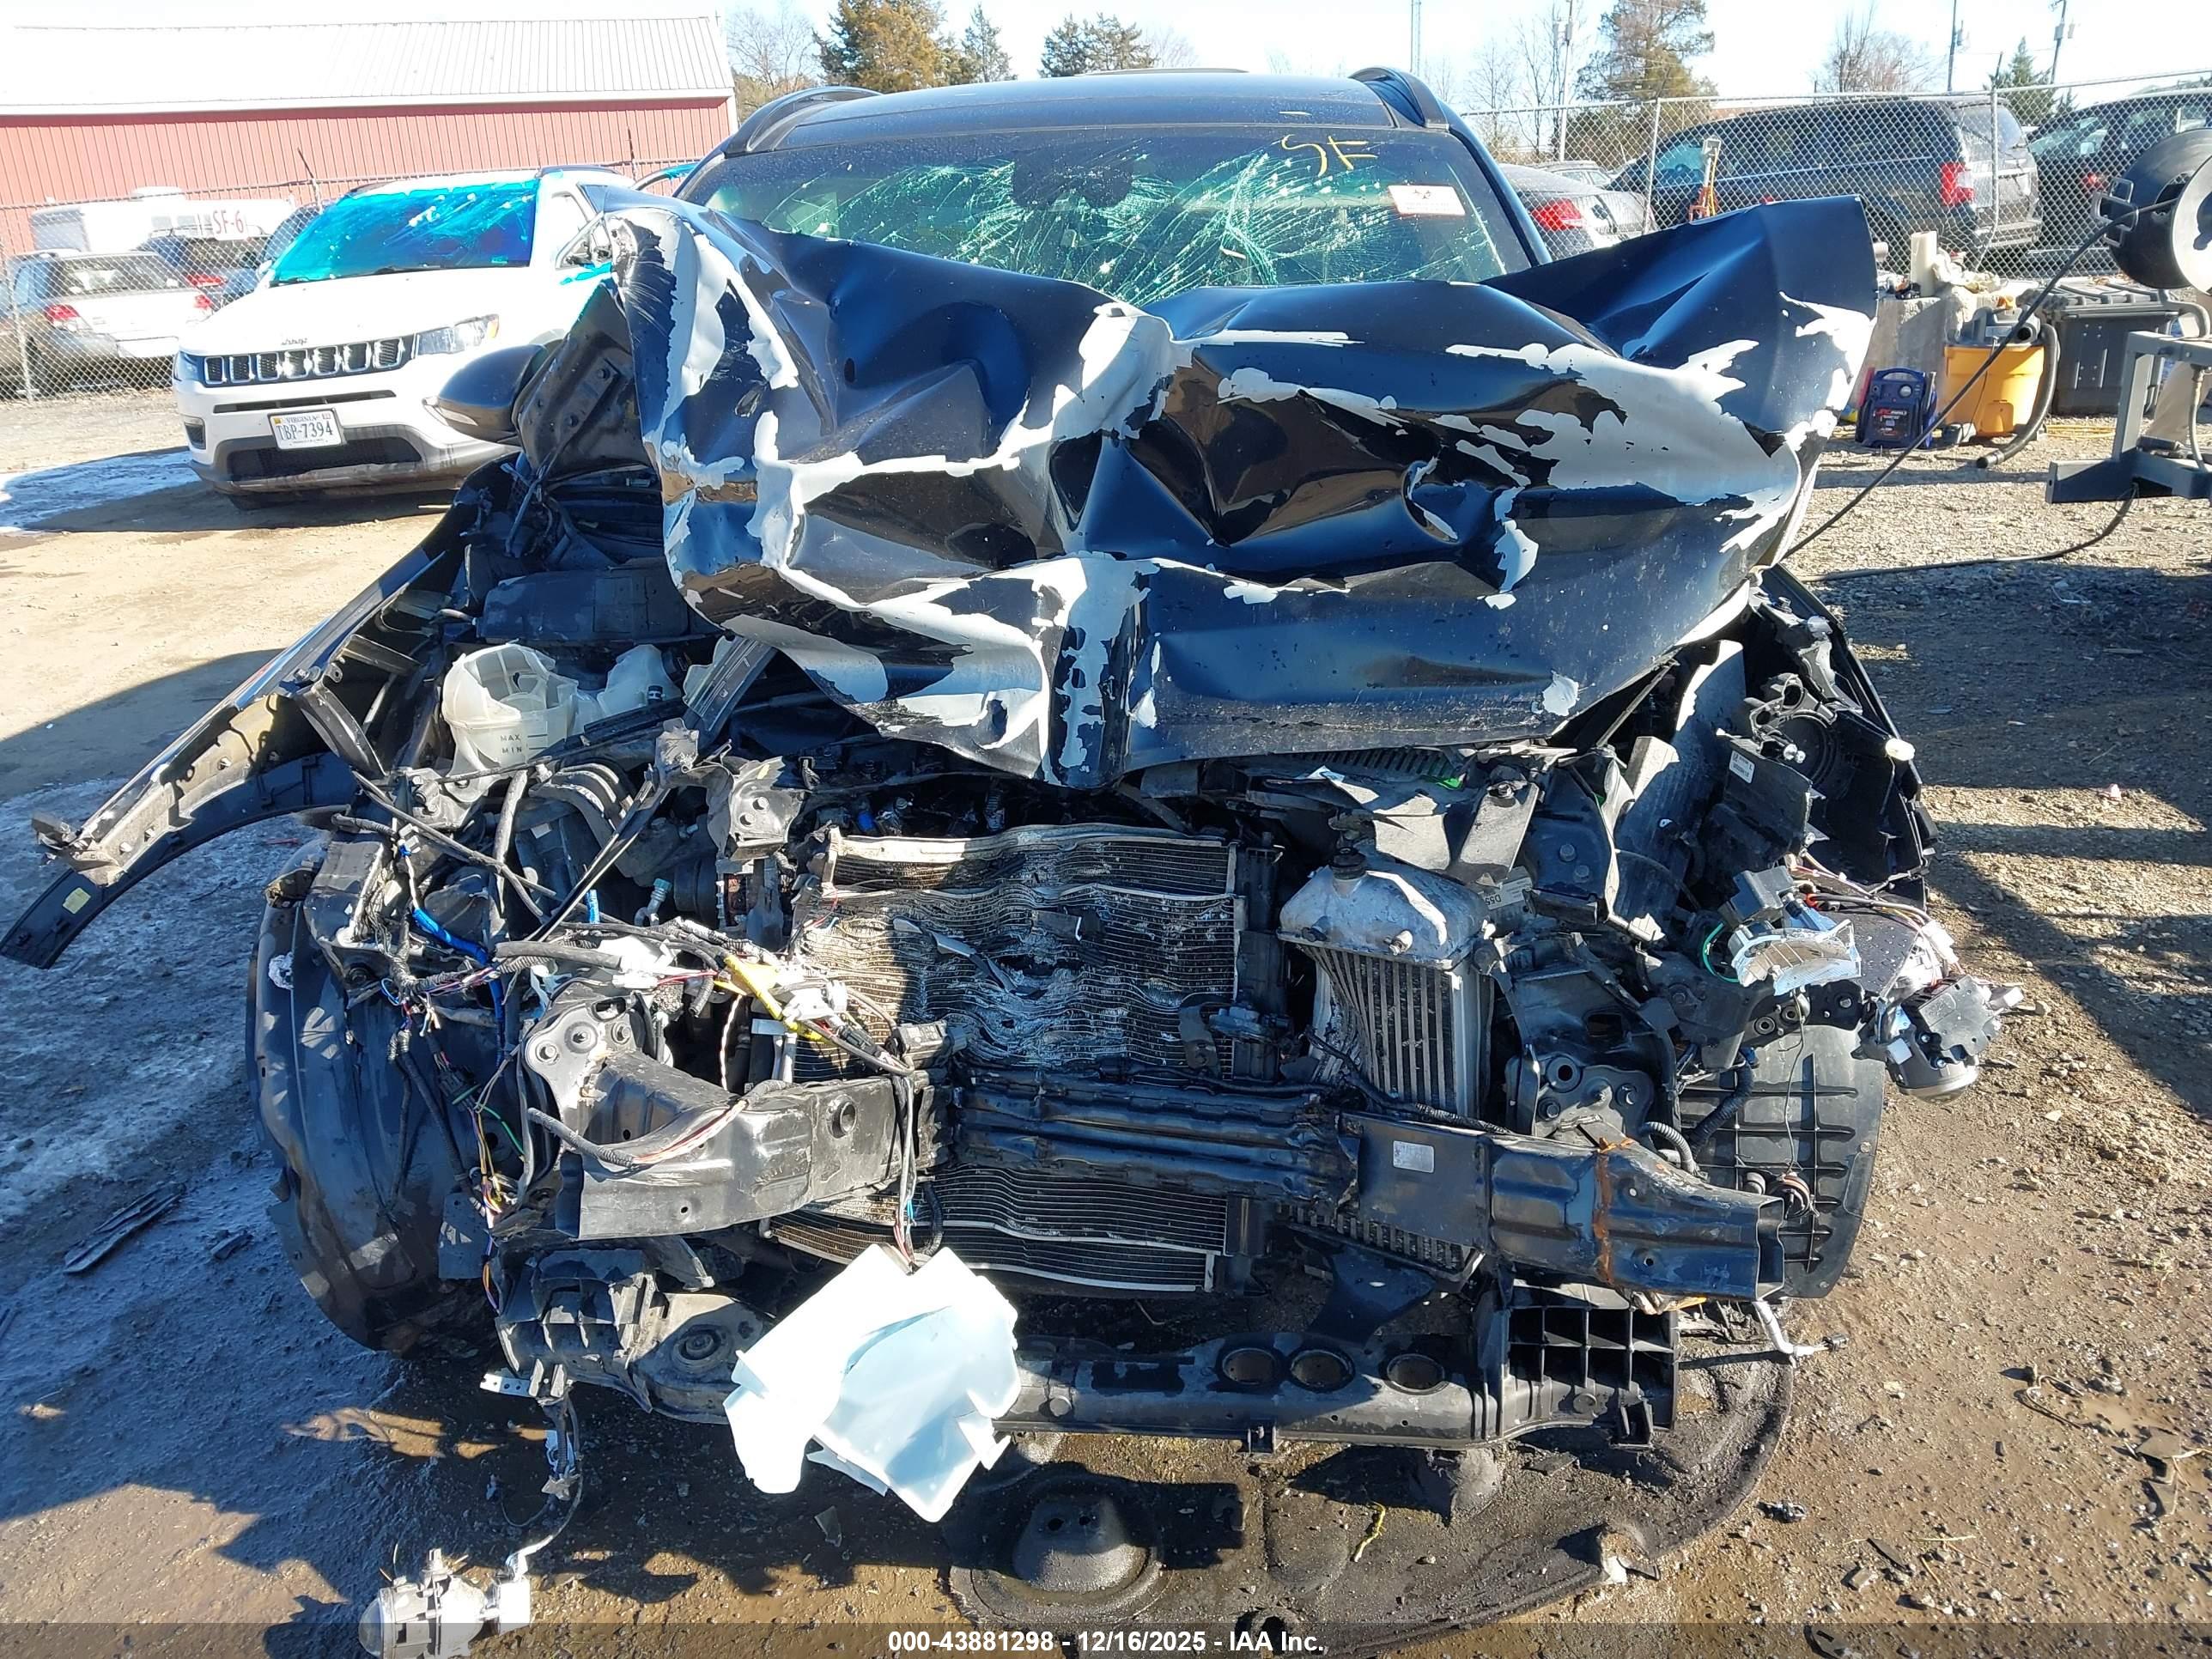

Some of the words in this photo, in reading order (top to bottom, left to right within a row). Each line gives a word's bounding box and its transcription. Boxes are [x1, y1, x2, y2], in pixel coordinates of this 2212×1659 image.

[1281, 134, 1378, 177] SF
[212, 210, 244, 234] SF-6
[276, 420, 333, 441] TBP-7394
